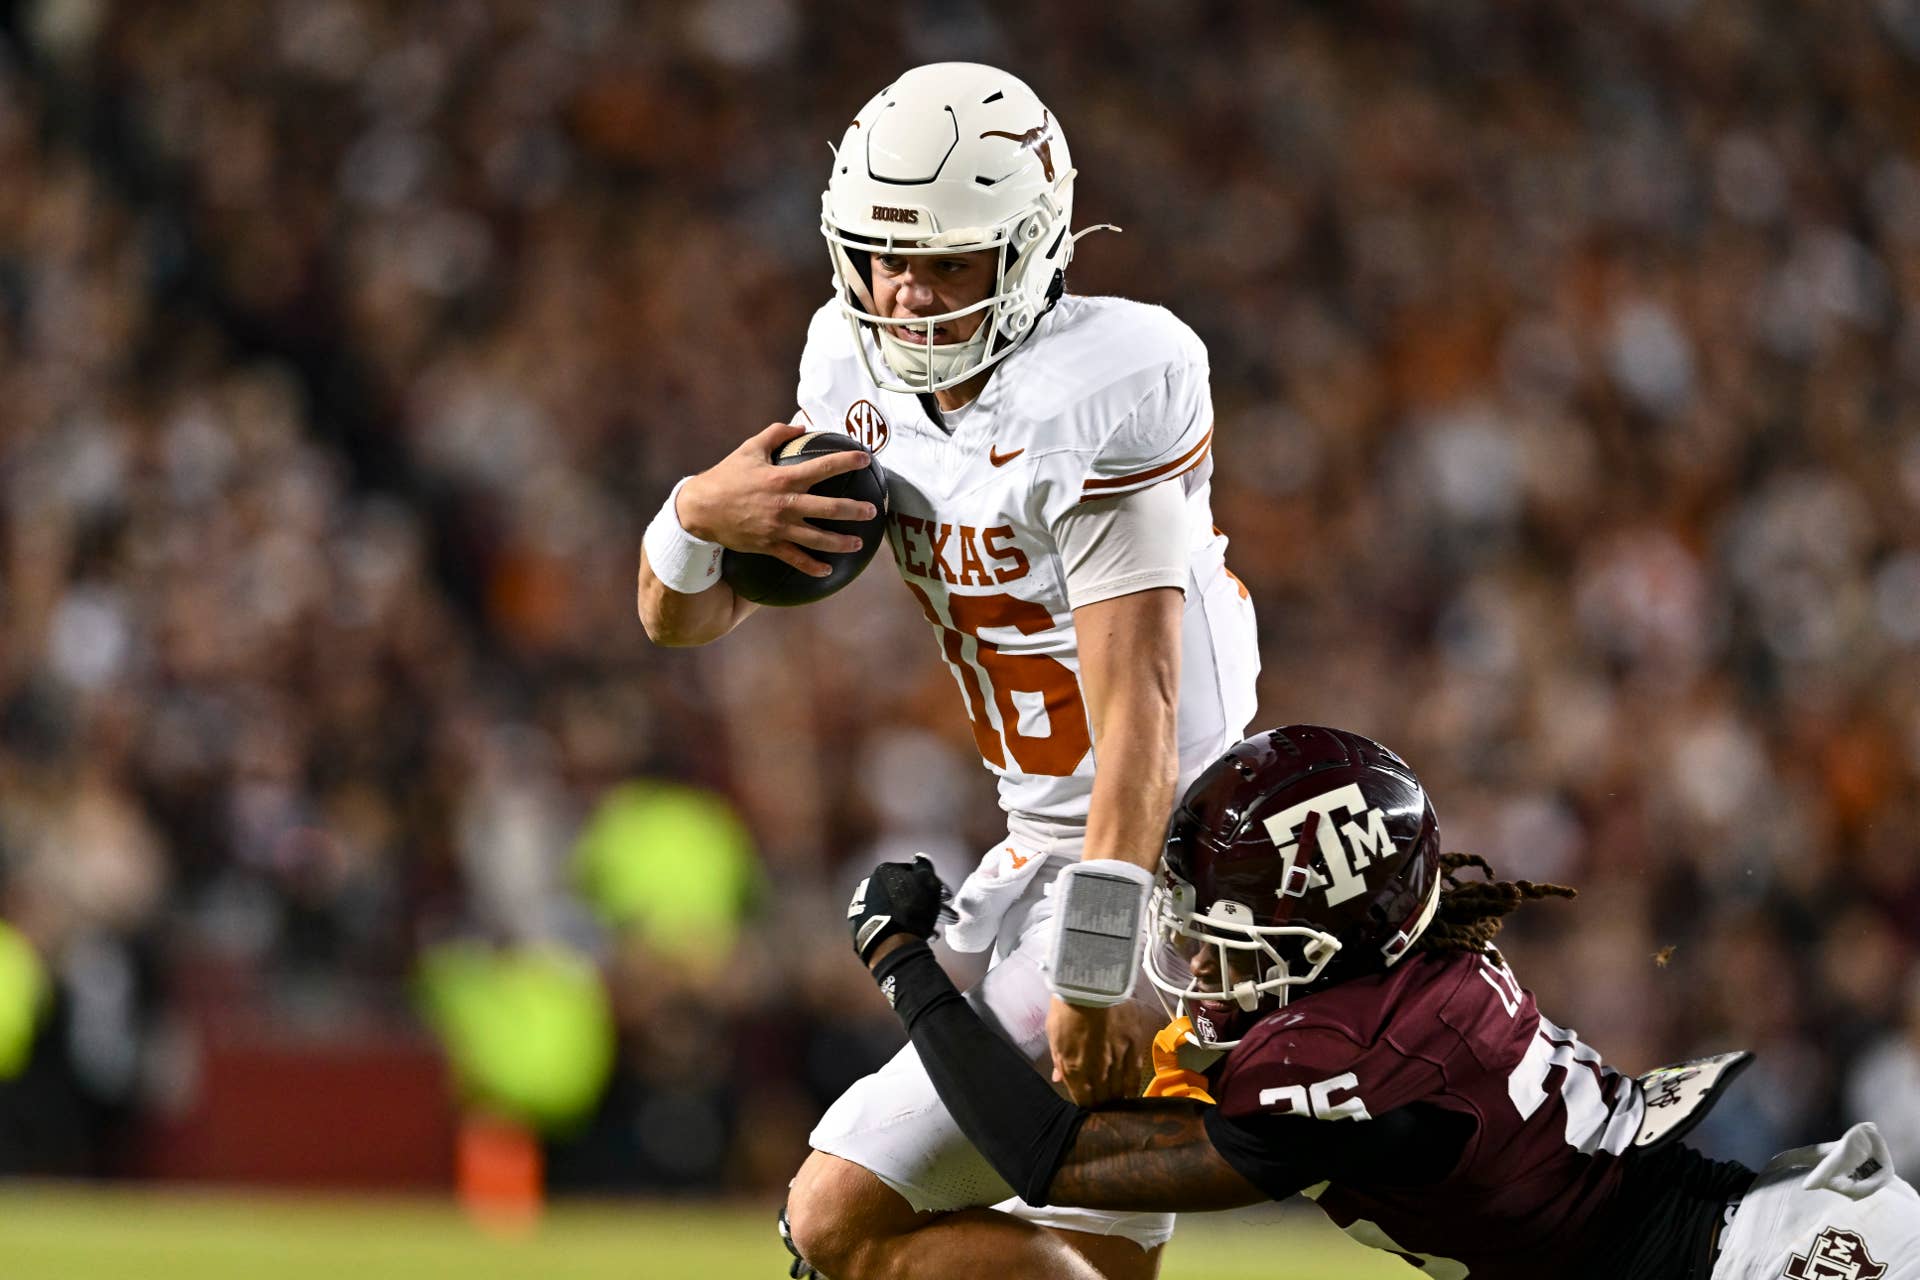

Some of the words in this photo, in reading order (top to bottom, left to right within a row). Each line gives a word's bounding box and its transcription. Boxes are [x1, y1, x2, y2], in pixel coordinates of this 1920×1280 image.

[871, 205, 919, 225] HORNS
[847, 400, 888, 453] SEC
[904, 580, 1092, 777] 16
